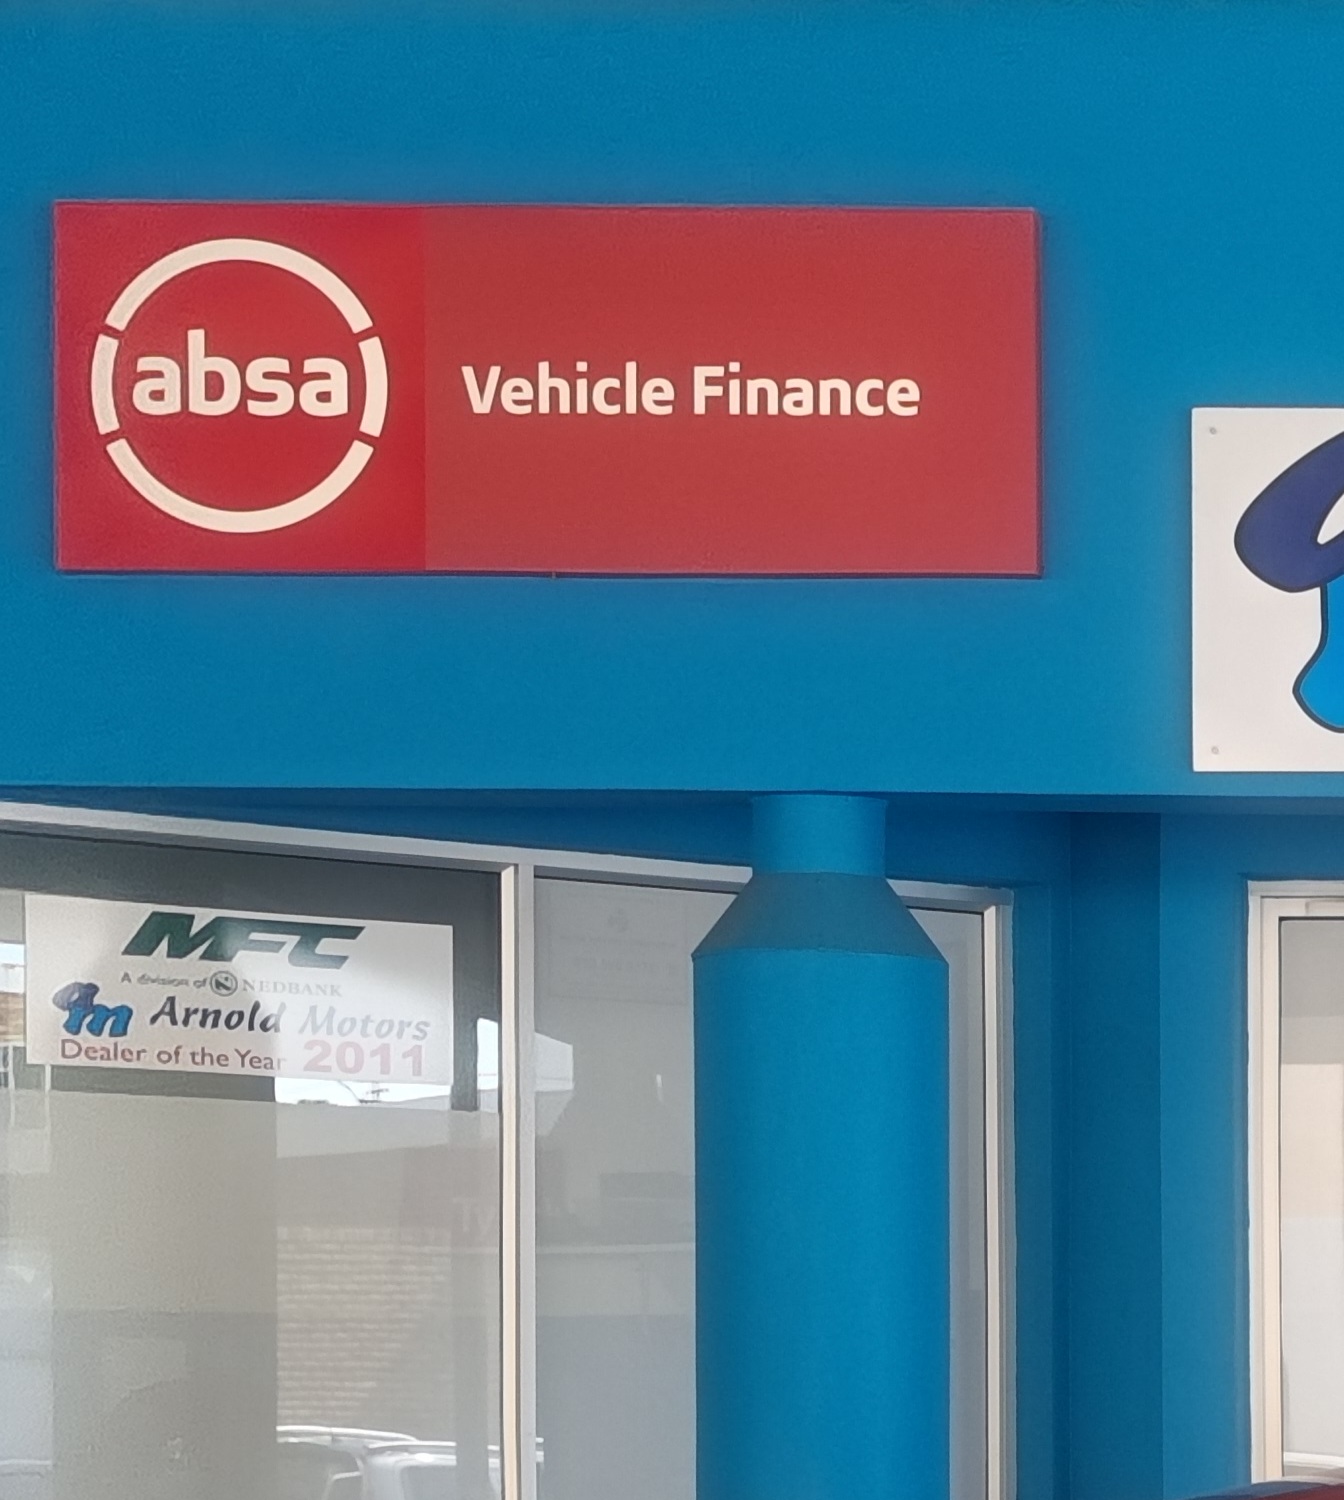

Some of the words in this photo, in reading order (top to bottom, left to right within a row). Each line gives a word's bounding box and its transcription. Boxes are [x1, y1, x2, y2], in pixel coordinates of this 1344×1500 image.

[131, 328, 350, 418] absa
[460, 361, 675, 416] Vehicle
[692, 364, 921, 418] Finance
[121, 910, 366, 970] MFC
[120, 970, 132, 985] A
[242, 977, 343, 998] NEDBANK
[149, 995, 283, 1034] Arnold
[298, 1003, 431, 1042] Motors
[60, 1038, 147, 1064] Dealer
[156, 1044, 181, 1066] of
[190, 1046, 231, 1068] the
[234, 1047, 287, 1072] Year
[302, 1039, 424, 1078] 2011
